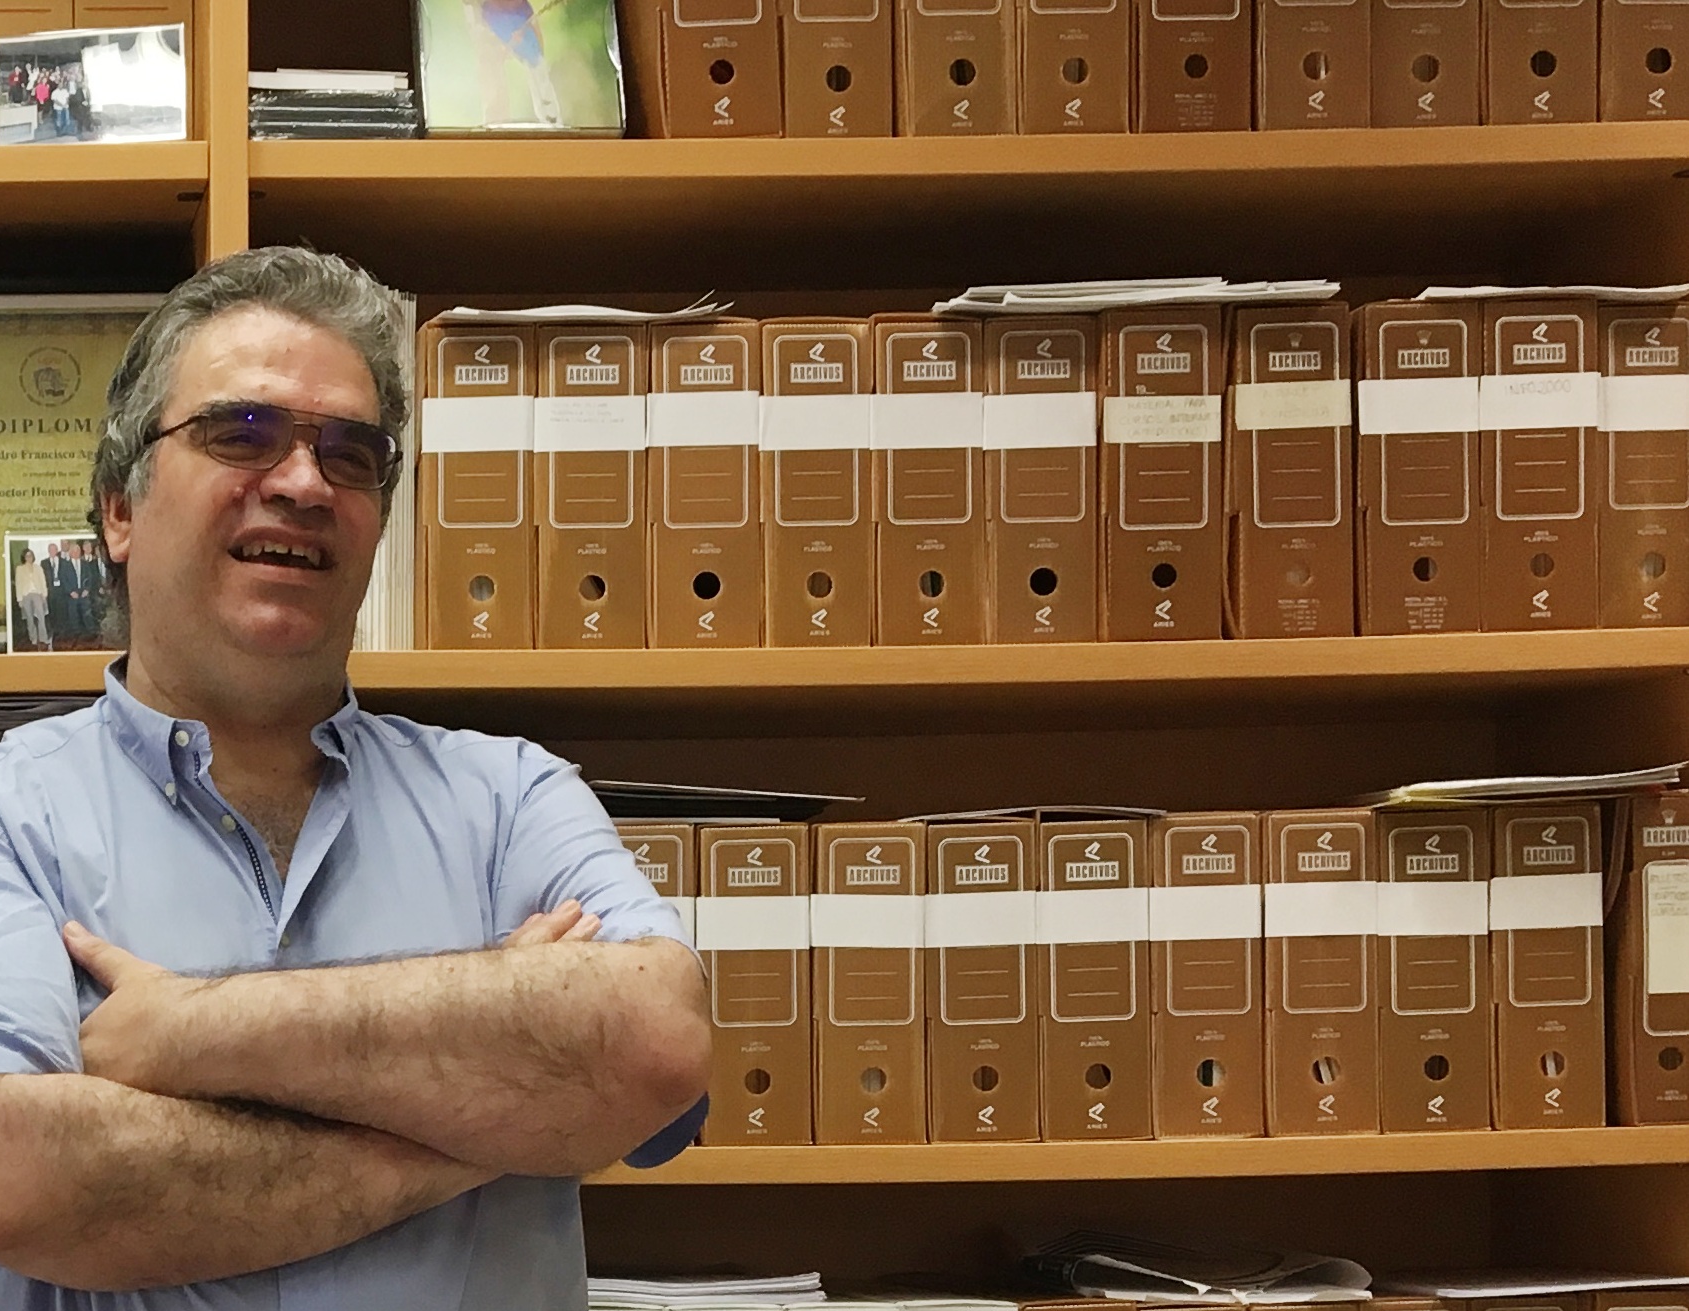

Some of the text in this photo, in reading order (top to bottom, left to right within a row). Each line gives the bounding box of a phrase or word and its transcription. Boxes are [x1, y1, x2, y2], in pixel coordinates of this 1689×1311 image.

[1272, 352, 1319, 369] ARCHIVOS
[1400, 350, 1447, 367] ARCHIVOS
[1516, 345, 1564, 362] ARCHIVOS
[1628, 348, 1676, 365] ARCHIVOS
[906, 362, 953, 379] ARCHIVOS
[1020, 361, 1067, 377] ARCHIVOS
[1140, 355, 1188, 372] ARCHIVOS
[458, 367, 506, 383] ARCHIVOS
[569, 366, 616, 382] ARCHIVOS
[683, 366, 731, 383] ARCHIVOS
[793, 365, 840, 382] ARCHIVOS
[21, 449, 76, 461] Francisco
[31, 486, 77, 499] Honoris
[1301, 853, 1348, 870] ARCHIVOS
[1409, 855, 1456, 872] ARCHIVOS
[1526, 847, 1573, 863] ARCHIVOS
[1069, 863, 1117, 879] ARCHIVOS
[1185, 856, 1232, 872] ARCHIVOS
[730, 868, 778, 885] ARCHIVOS
[958, 866, 1006, 883] ARCHIVOS
